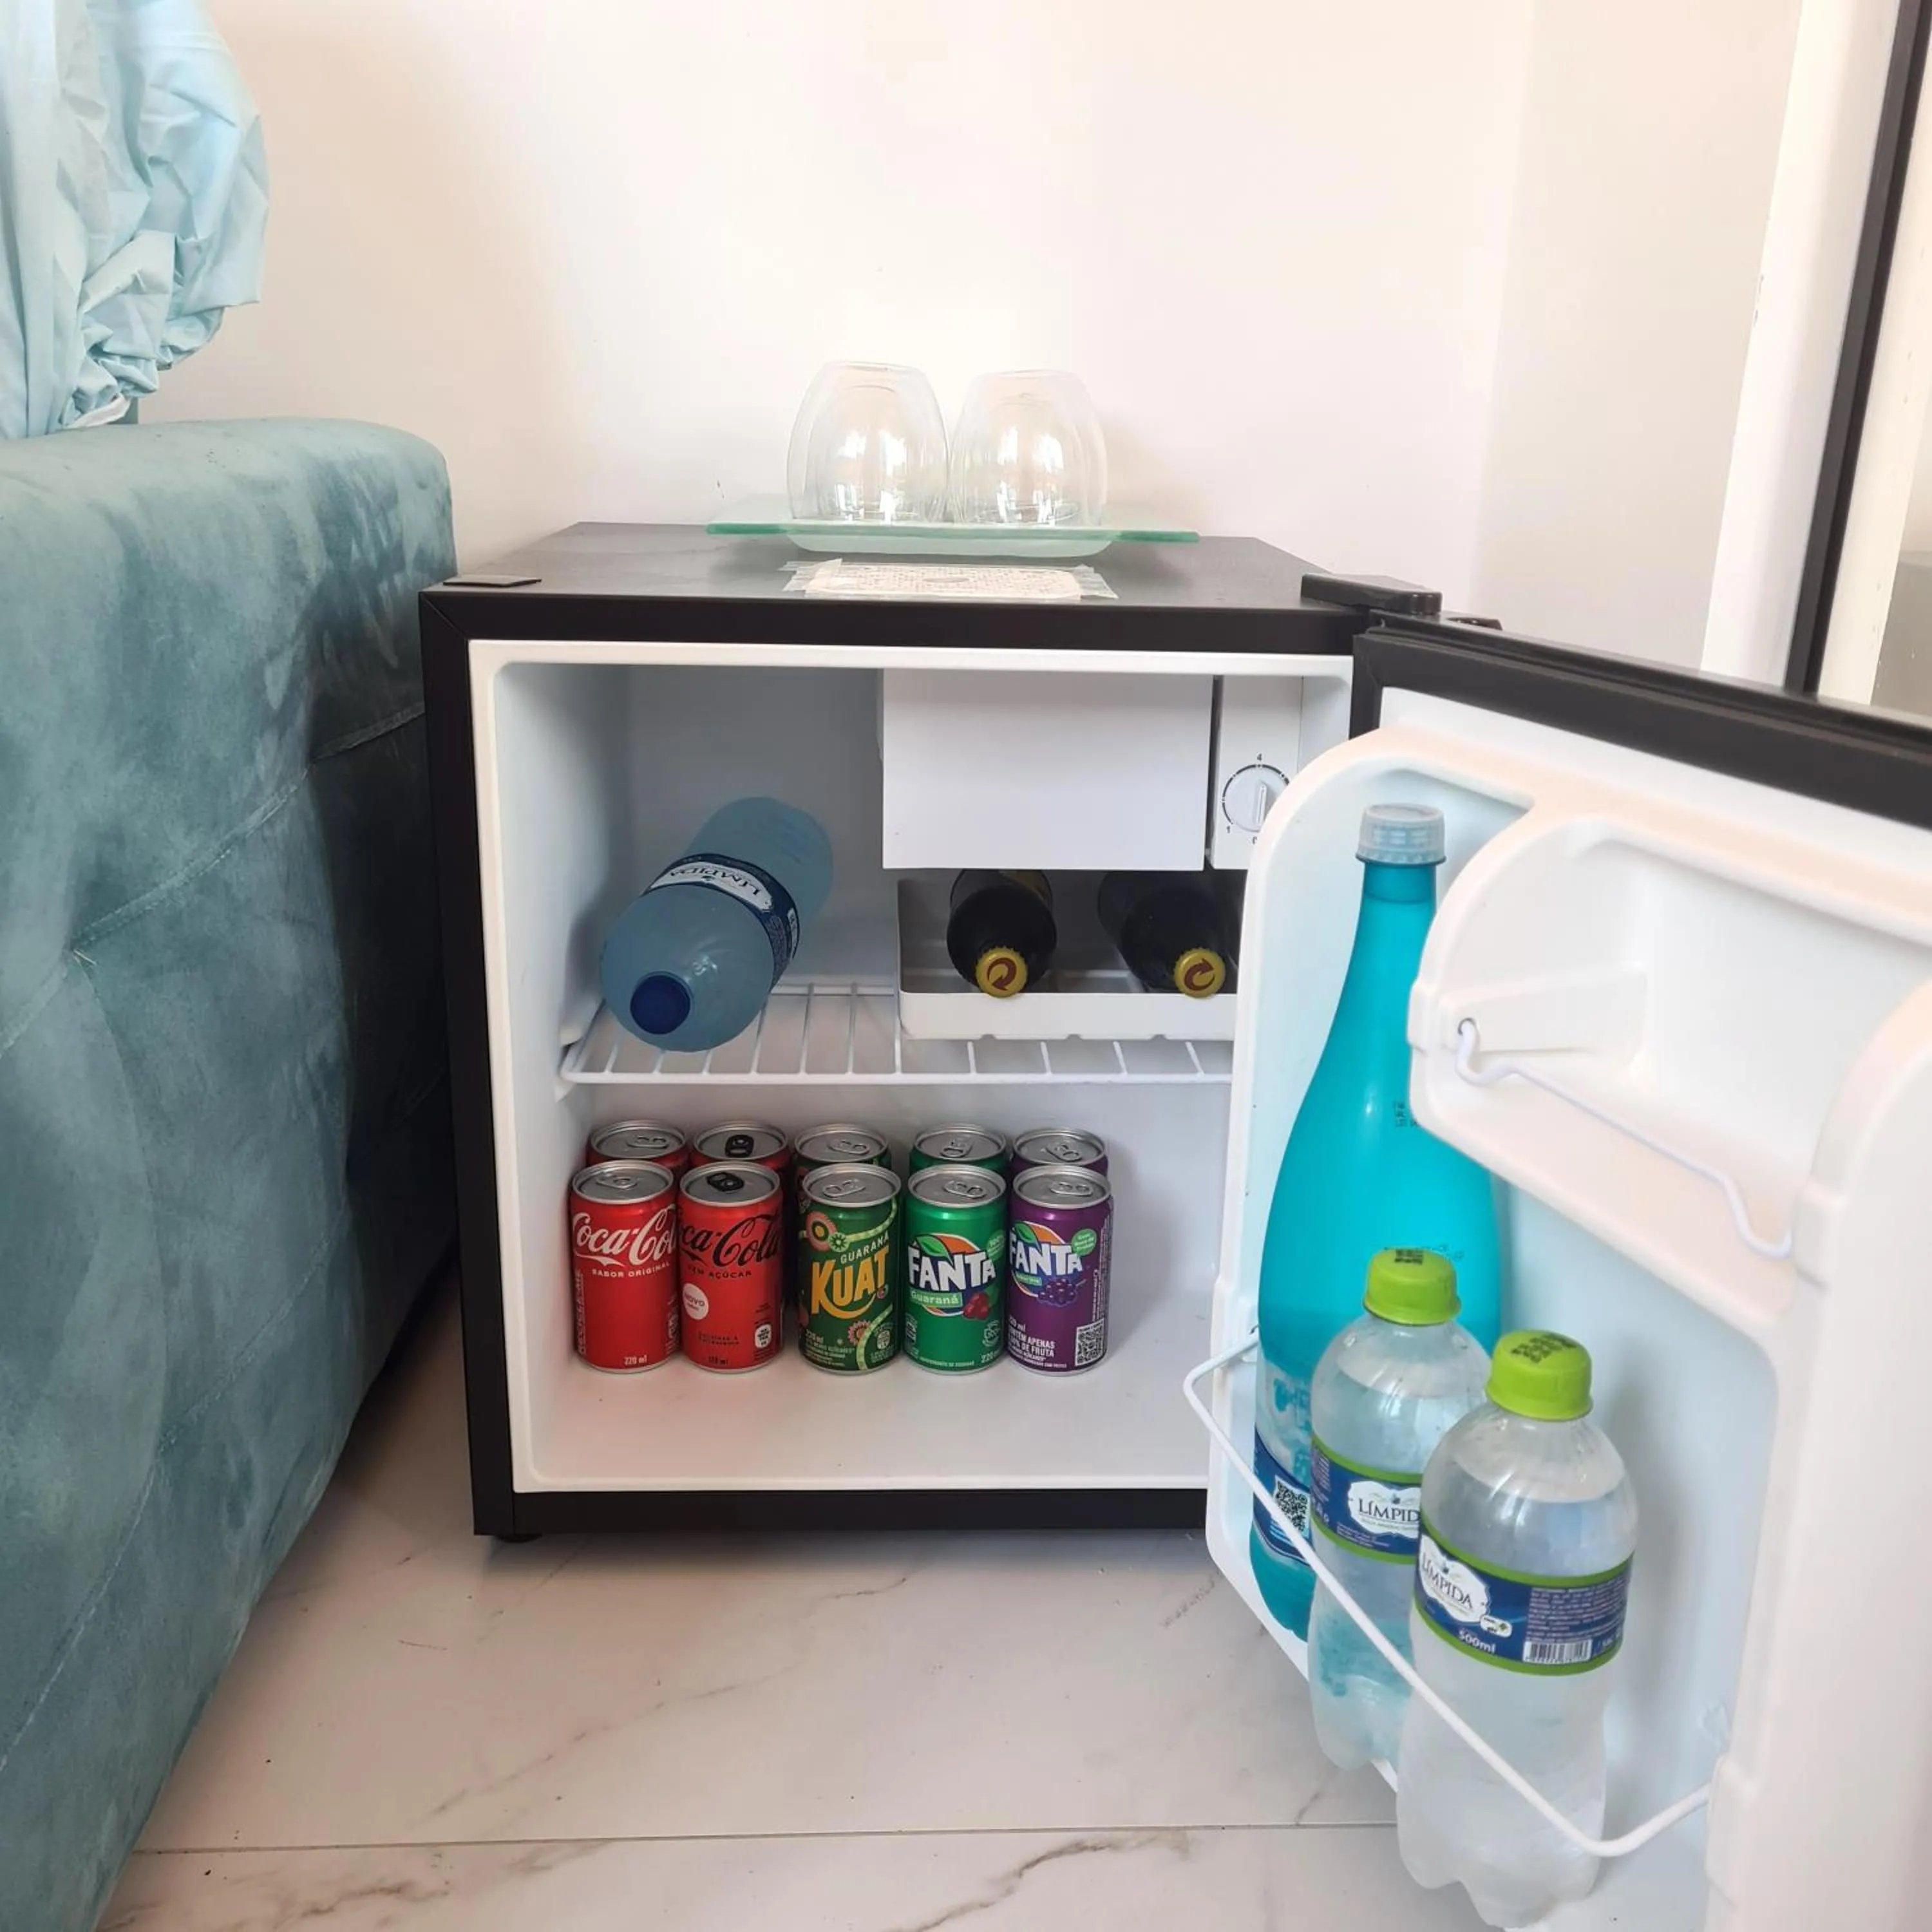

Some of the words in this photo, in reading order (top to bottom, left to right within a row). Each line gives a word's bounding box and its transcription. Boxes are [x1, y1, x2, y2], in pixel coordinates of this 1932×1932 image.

[1256, 753, 1262, 761] 4
[680, 1214, 779, 1267] ca-Cola
[1009, 1230, 1083, 1276] FANTA
[592, 1268, 624, 1278] SABOR
[628, 1262, 670, 1278] ORIGINAL
[688, 1265, 705, 1275] EM
[907, 1245, 996, 1291] FANTA
[811, 1245, 889, 1319] KUAT
[1027, 1336, 1056, 1349] APENAS
[1031, 1345, 1055, 1358] FRUTA
[1358, 1498, 1421, 1522] LÍMPID
[1421, 1552, 1474, 1609] LÍMPIDA
[1459, 1627, 1496, 1654] 500ml
